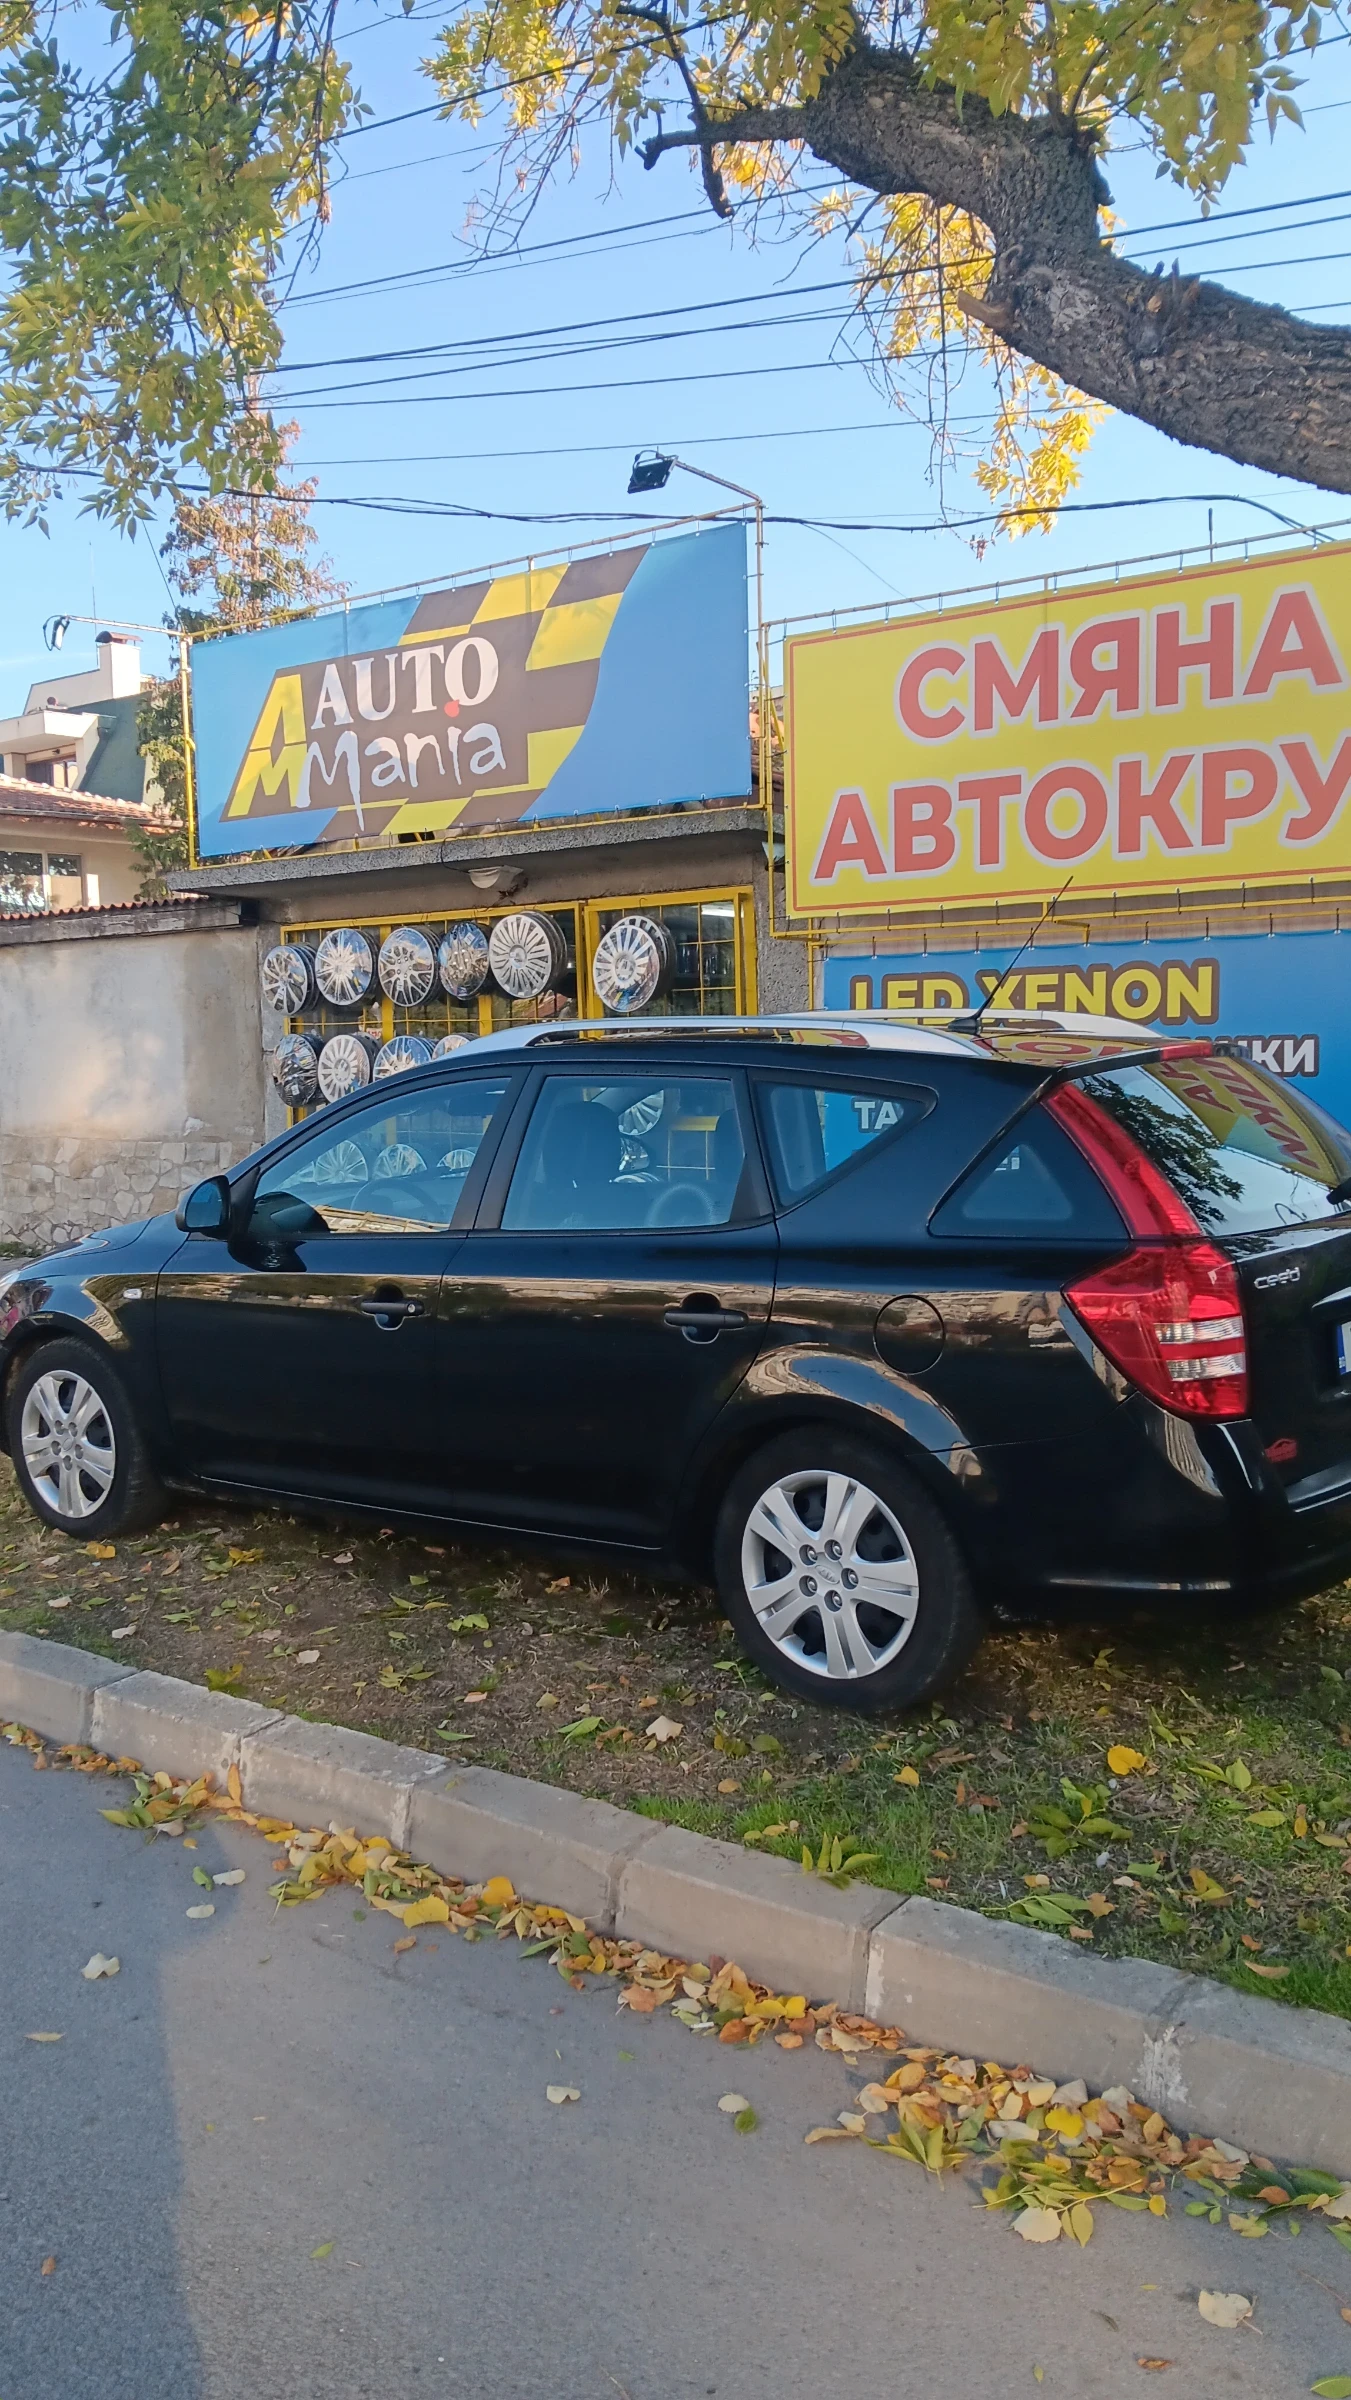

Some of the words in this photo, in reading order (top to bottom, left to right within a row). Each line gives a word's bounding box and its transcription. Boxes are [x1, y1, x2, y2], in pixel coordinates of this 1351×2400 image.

[310, 636, 499, 730] AUTO
[897, 589, 1345, 741] СМЯНА
[295, 722, 506, 831] Mania
[813, 735, 1351, 880] АВТОКРУ
[981, 965, 1213, 1024] XENON
